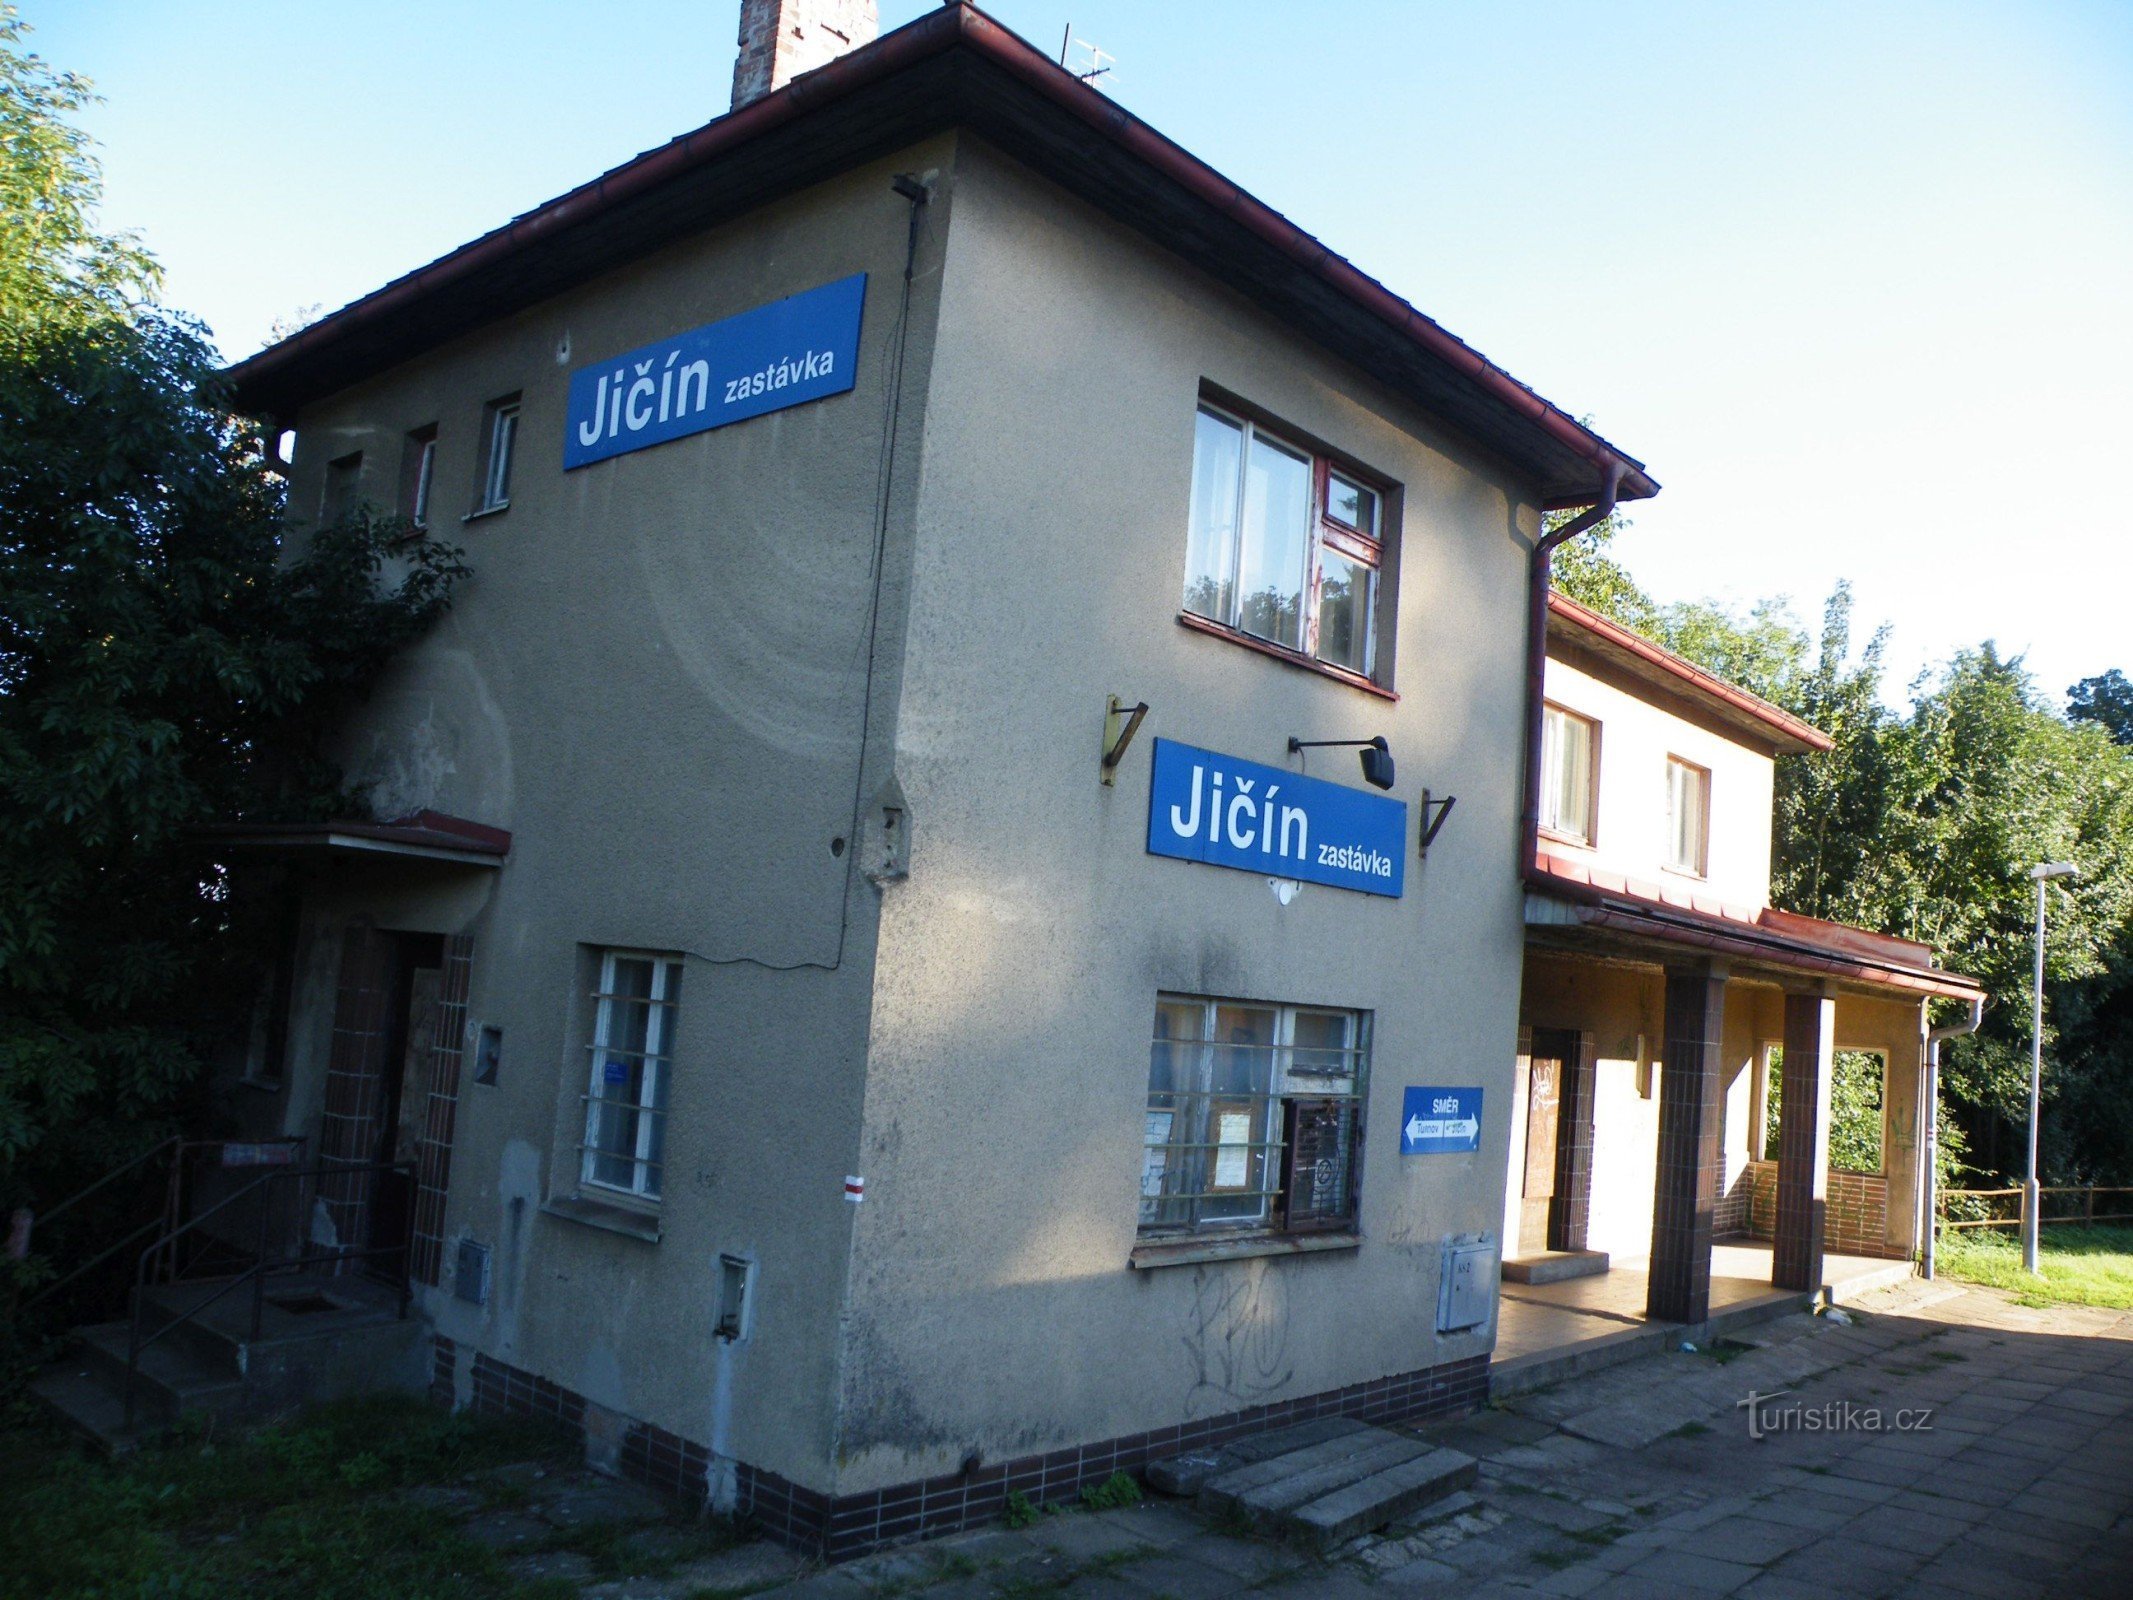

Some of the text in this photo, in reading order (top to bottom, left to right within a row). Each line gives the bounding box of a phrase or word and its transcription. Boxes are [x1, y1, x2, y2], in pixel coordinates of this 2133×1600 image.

[579, 350, 834, 446] Jičín zastávka
[1170, 765, 1391, 877] Jičín zastávka
[1432, 1095, 1459, 1113] SMĚR
